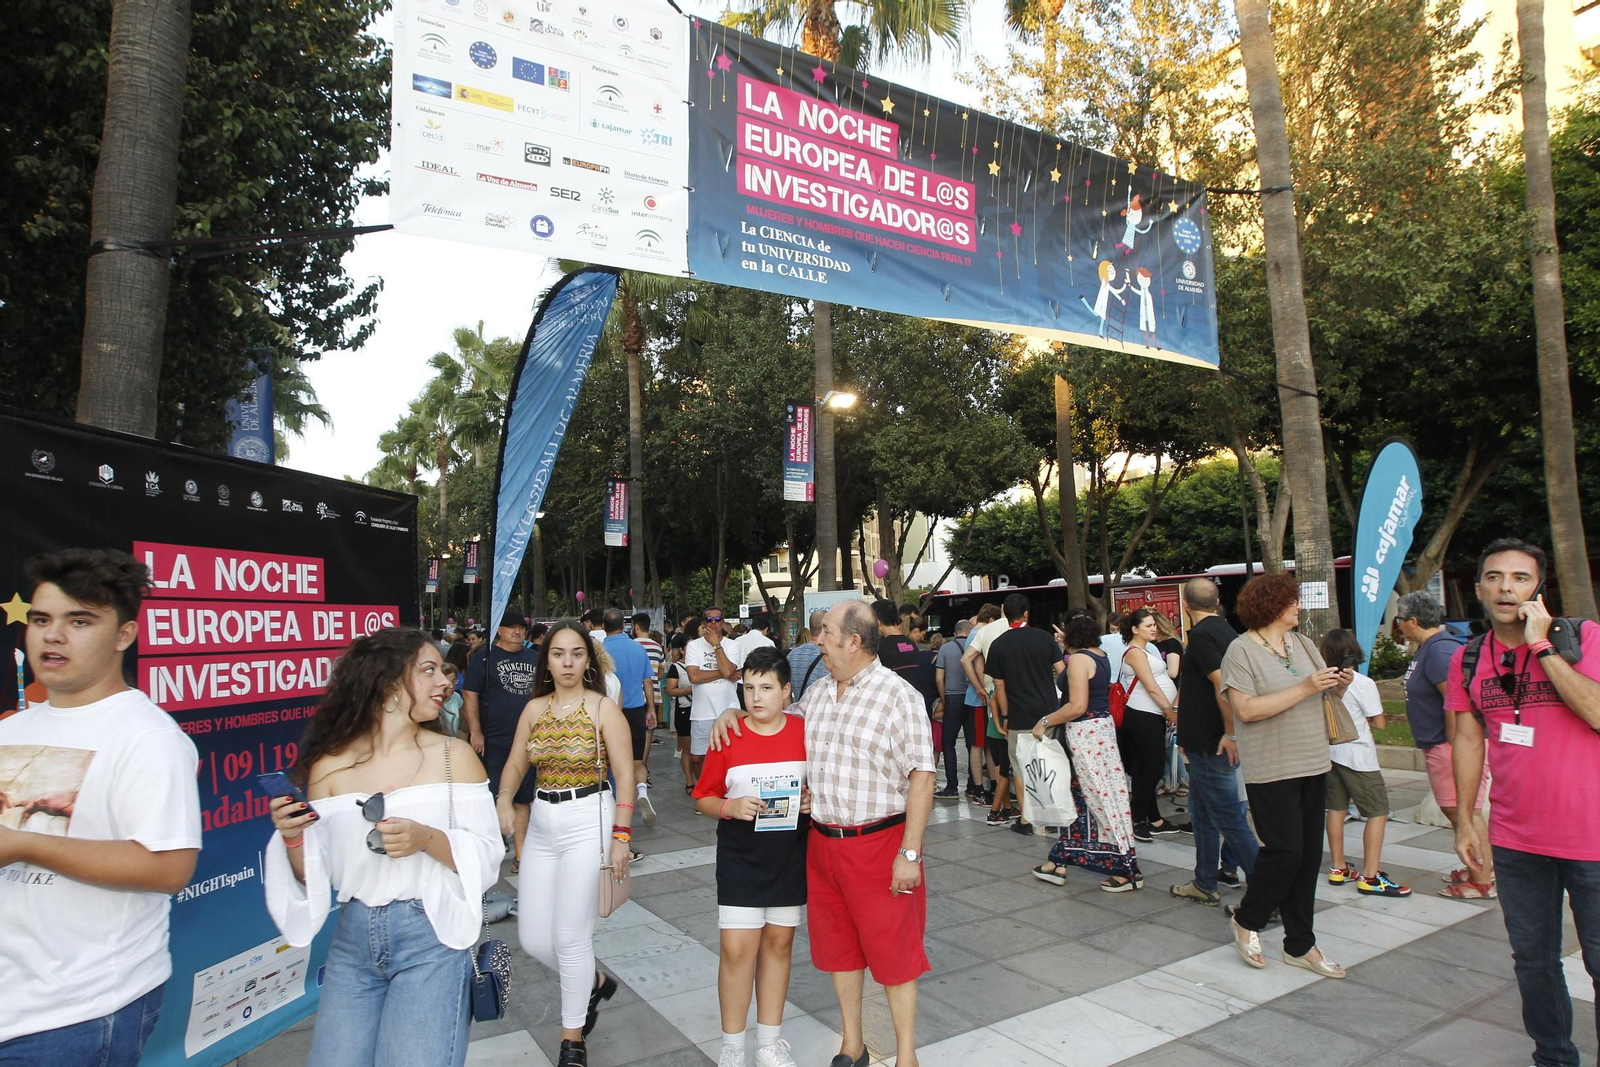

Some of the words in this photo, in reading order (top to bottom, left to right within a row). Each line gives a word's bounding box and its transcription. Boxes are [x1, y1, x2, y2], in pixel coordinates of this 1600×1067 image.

[416, 105, 446, 117] Colaboran
[518, 104, 540, 115] FECYT
[745, 82, 783, 120] LA
[798, 99, 892, 153] NOCHE
[602, 122, 632, 135] cajamar
[422, 160, 458, 174] IDEAL
[744, 122, 874, 186] EUROPEA
[884, 164, 916, 196] DE
[922, 176, 970, 211] L@S
[550, 187, 580, 202] SER
[744, 163, 970, 246] INVESTIGADOR@S
[741, 221, 757, 236] La
[760, 224, 815, 250] CIENCIA
[818, 240, 832, 254] de
[746, 204, 795, 225] MUJERES
[796, 216, 804, 226] Y
[804, 218, 854, 238] HOMBRES
[854, 230, 875, 242] QUE
[876, 234, 906, 250] HACEN
[906, 242, 940, 258] CIENCIA
[941, 252, 962, 265] PARA
[962, 257, 972, 267] TI
[742, 240, 756, 253] tu
[758, 242, 852, 273] UNIVERSIDAD
[742, 260, 758, 272] en
[760, 259, 774, 274] la
[778, 264, 828, 284] CALLE
[1176, 278, 1204, 288] UNIVERSIDAD
[250, 418, 259, 431] DE
[790, 452, 795, 461] LA
[500, 443, 559, 577] UNIVERSIDAD
[1376, 474, 1410, 565] cajamar
[145, 551, 196, 590] LA
[214, 556, 318, 594] NOCHE
[146, 608, 302, 646] EUROPEA
[312, 610, 344, 640] DE
[149, 656, 332, 704] INVESTIGAD
[1482, 680, 1494, 688] LA
[1526, 683, 1538, 692] DE
[180, 719, 212, 735] ERES
[214, 718, 224, 731] Y
[224, 710, 279, 730] HOMBRES
[280, 709, 302, 721] QUE
[223, 750, 253, 782] 09
[273, 742, 298, 771] 19
[201, 789, 270, 832] ndalu
[176, 866, 255, 904] #NIGHTspain
